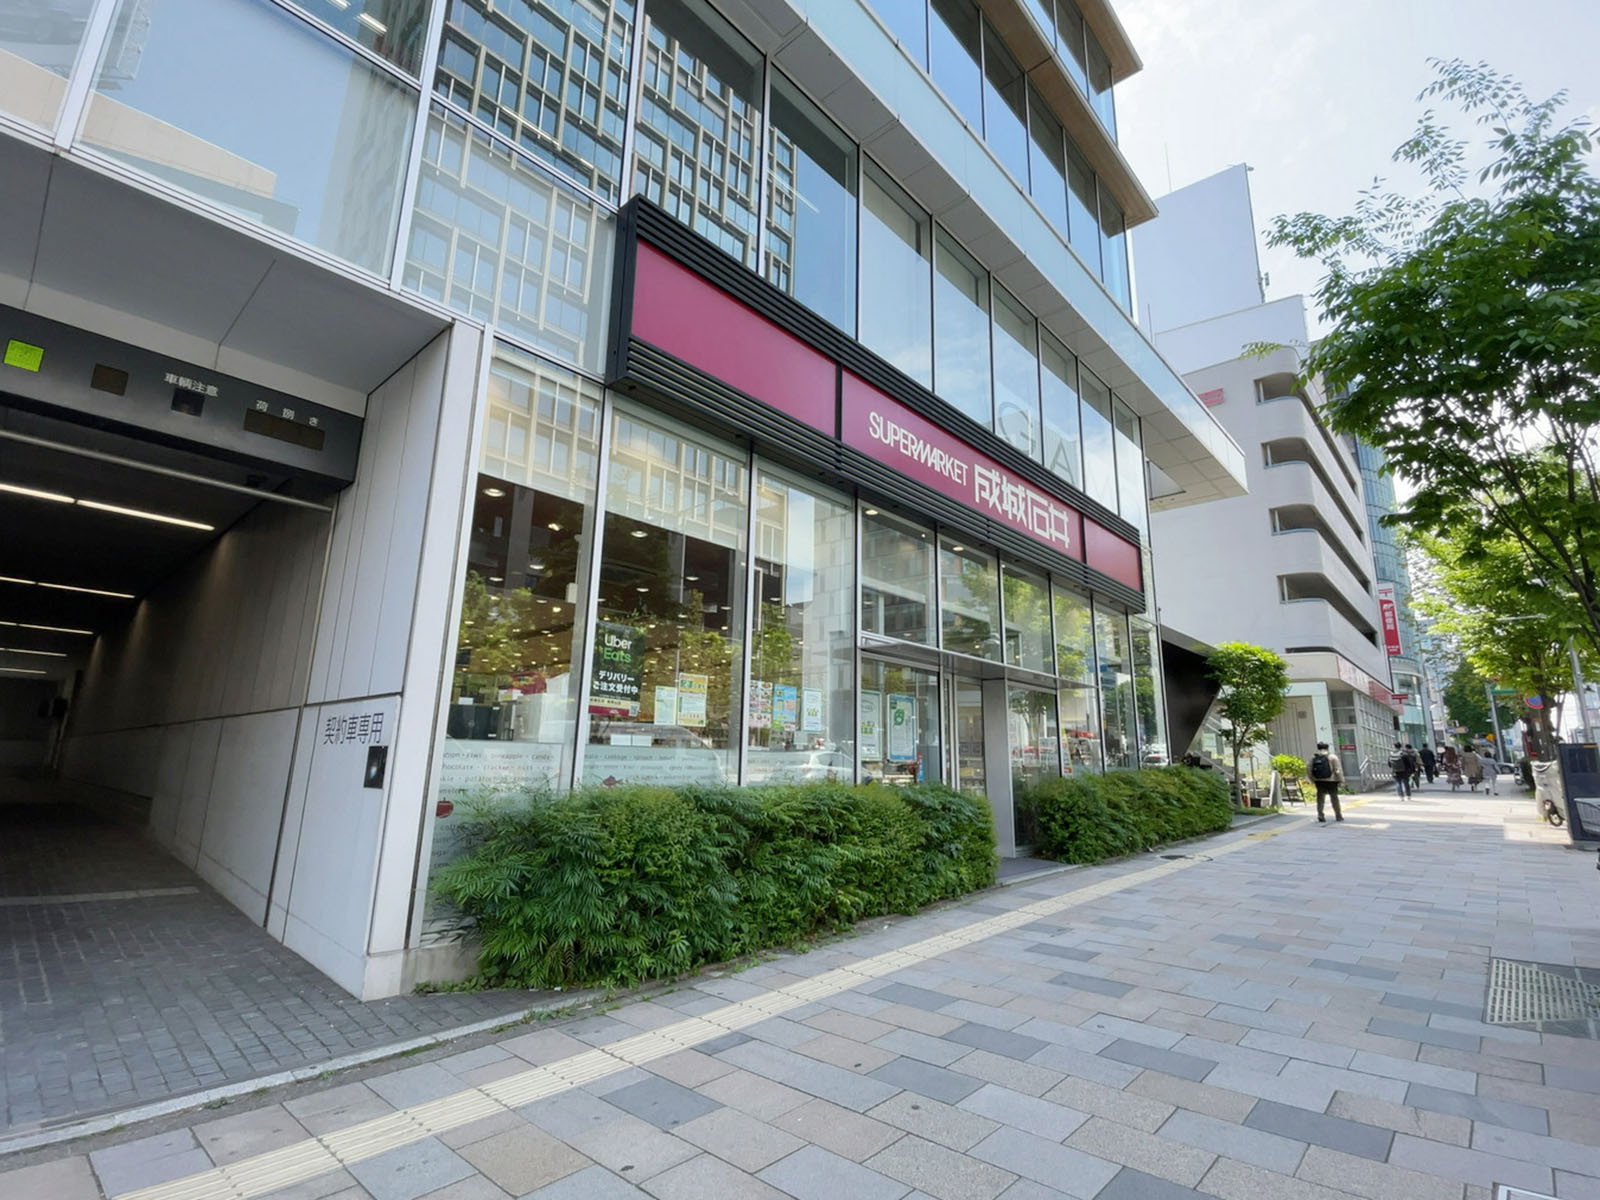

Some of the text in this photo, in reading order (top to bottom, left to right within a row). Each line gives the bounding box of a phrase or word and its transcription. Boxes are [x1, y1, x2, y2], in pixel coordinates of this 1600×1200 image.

[868, 411, 969, 487] SUPERMARKET
[973, 462, 1070, 548] 成城石井
[604, 633, 633, 650] Uber
[603, 647, 632, 663] Eats
[598, 670, 635, 683] デリバリー
[592, 680, 639, 695] ご注文受付中
[323, 712, 384, 745] 契約車専用
